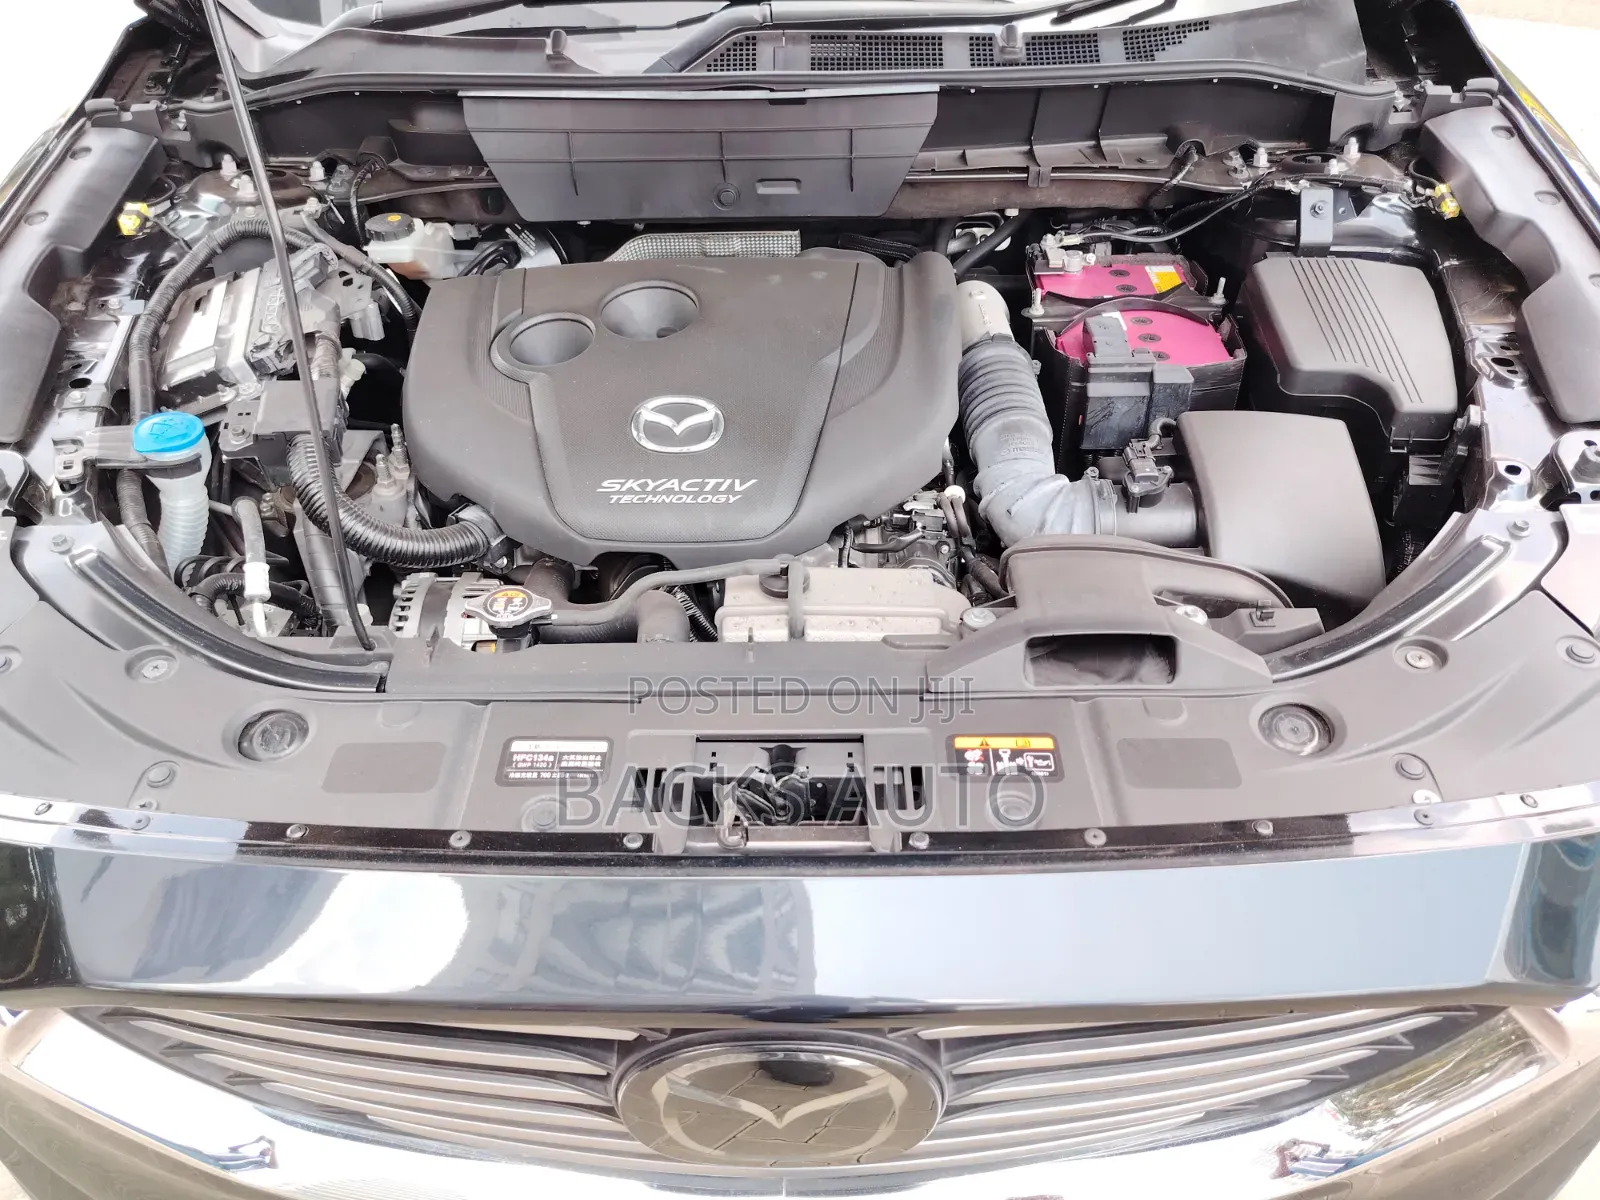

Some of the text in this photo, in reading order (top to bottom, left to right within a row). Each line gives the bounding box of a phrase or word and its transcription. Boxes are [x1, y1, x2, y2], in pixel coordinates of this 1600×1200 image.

[596, 478, 758, 492] SKYACTIV
[608, 494, 742, 504] TECHNOLOGY
[512, 753, 554, 762] HFC134a
